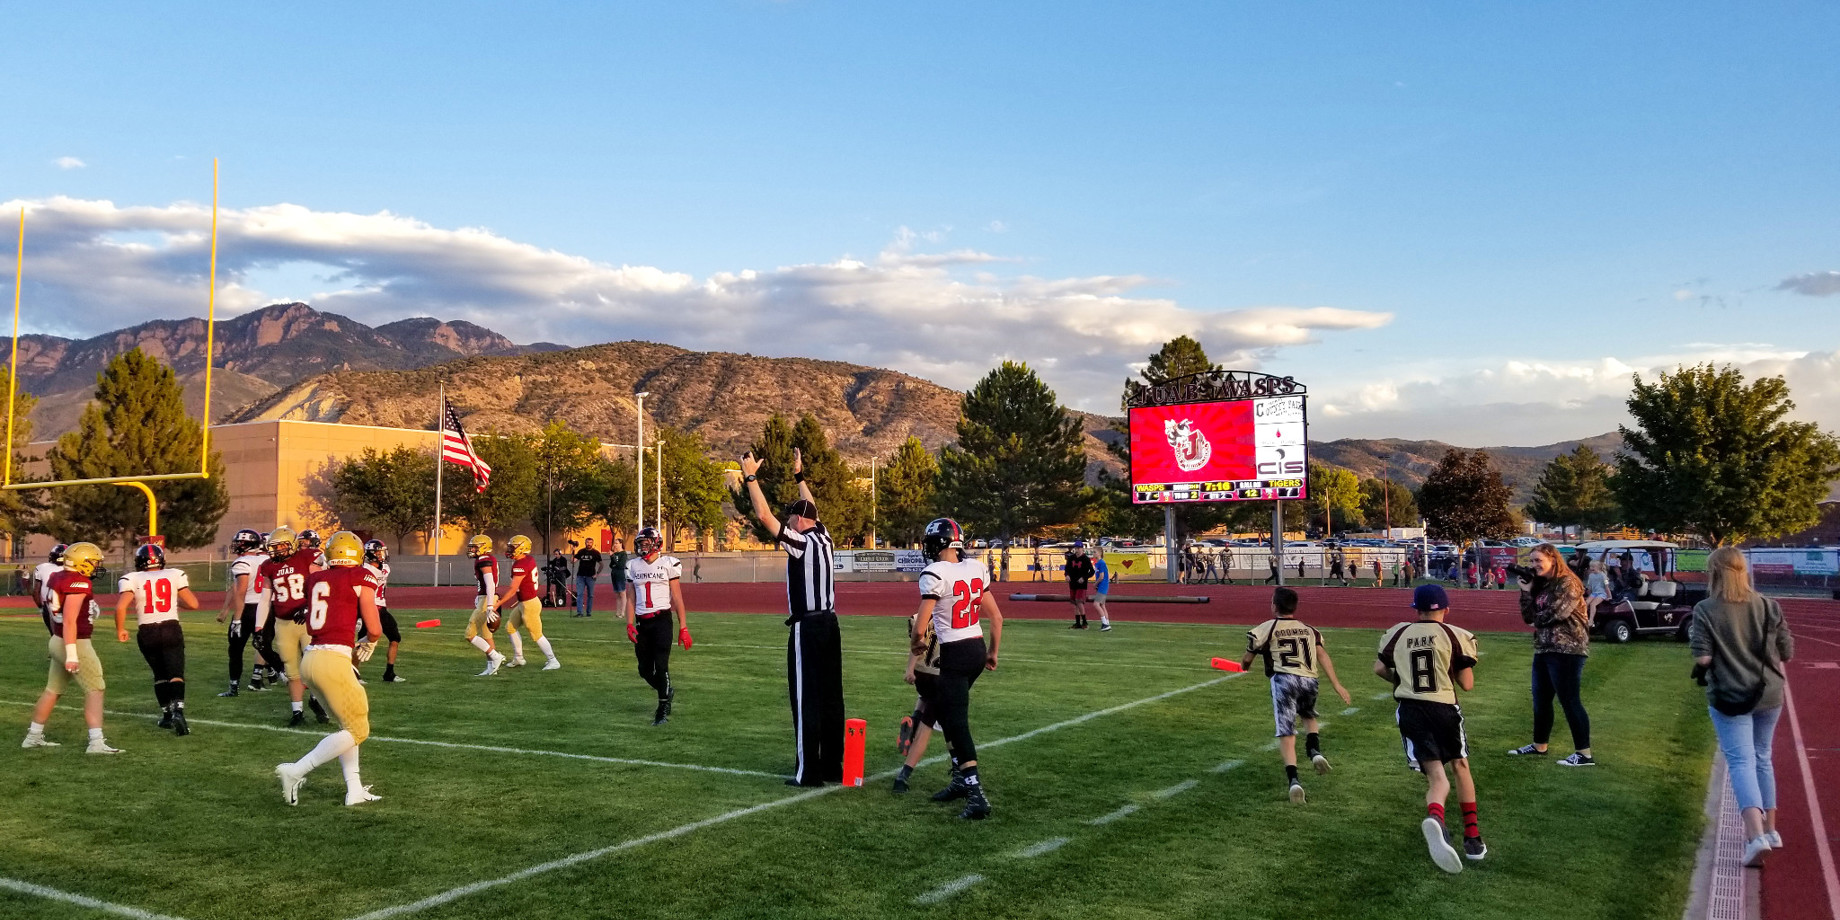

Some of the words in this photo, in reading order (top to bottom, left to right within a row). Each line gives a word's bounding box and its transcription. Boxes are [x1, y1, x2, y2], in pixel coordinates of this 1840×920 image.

[1137, 384, 1198, 404] JUAB
[1221, 375, 1295, 398] WASPS
[1136, 484, 1165, 492] WASPS
[1244, 488, 1258, 498] 12
[1268, 479, 1301, 488] TIGERS
[1284, 488, 1292, 497] 7
[1145, 492, 1152, 501] 7
[1190, 491, 1198, 499] 2
[276, 566, 294, 577] JUAB
[144, 577, 171, 614] 19
[273, 573, 305, 603] 58
[645, 581, 653, 609] 1
[310, 581, 331, 631] 6
[952, 577, 984, 630] 22
[1406, 635, 1437, 648] PARK
[1277, 636, 1313, 672] 21
[1409, 648, 1439, 695] 8
